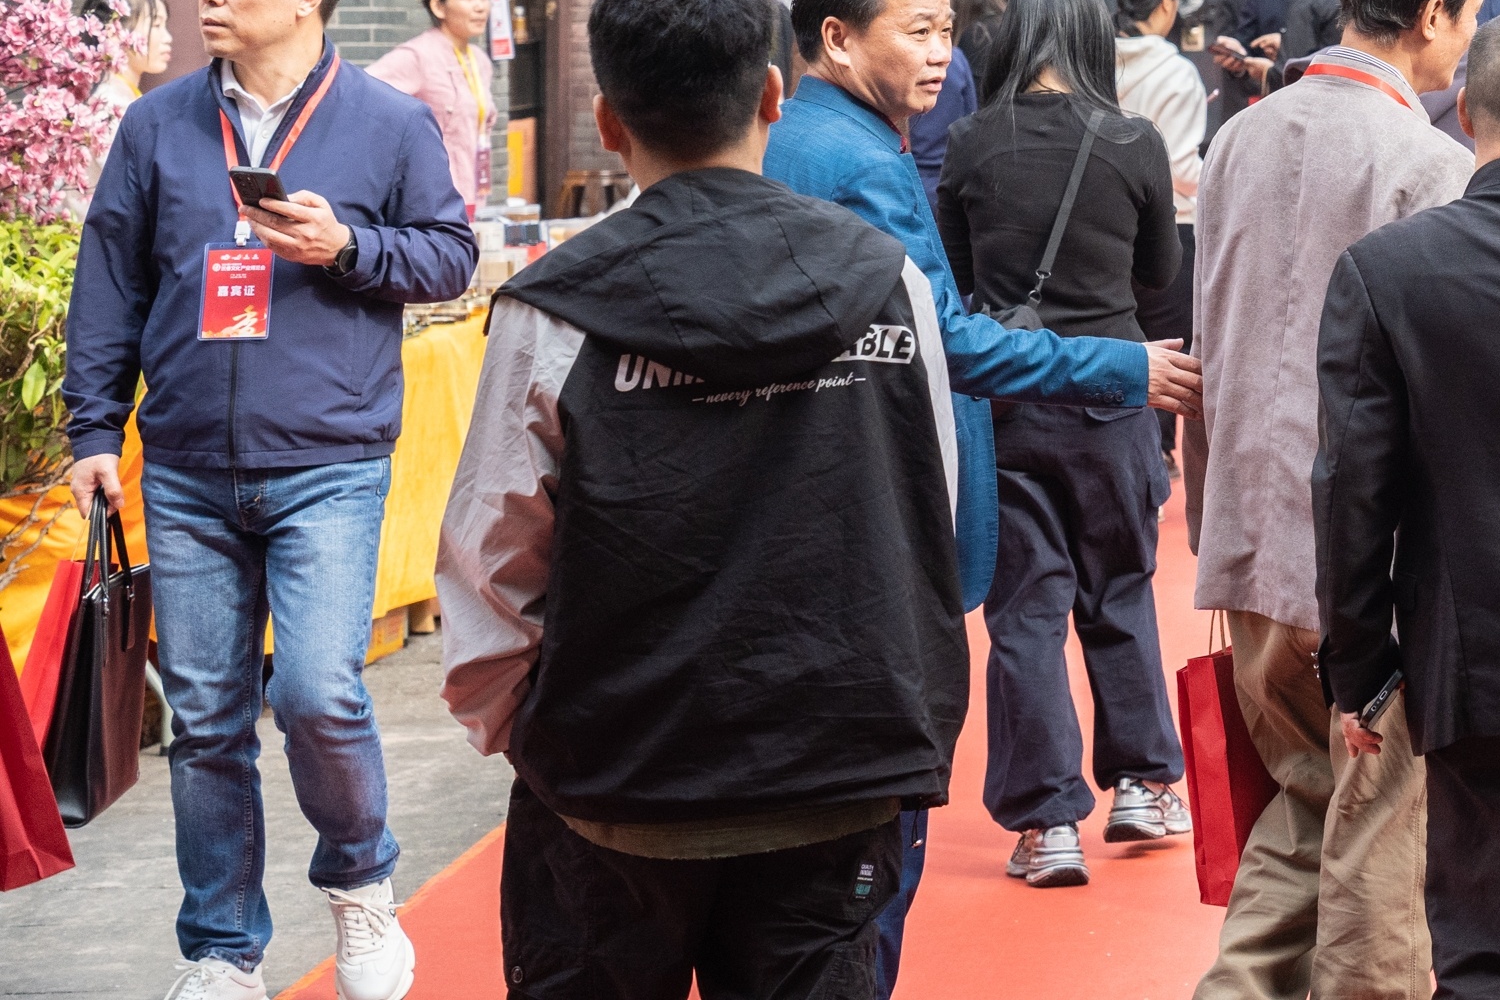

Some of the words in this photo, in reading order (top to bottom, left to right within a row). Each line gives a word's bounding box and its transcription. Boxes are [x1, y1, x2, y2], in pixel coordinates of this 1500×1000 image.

[217, 285, 256, 297] 嘉宾证
[755, 379, 816, 401] reference
